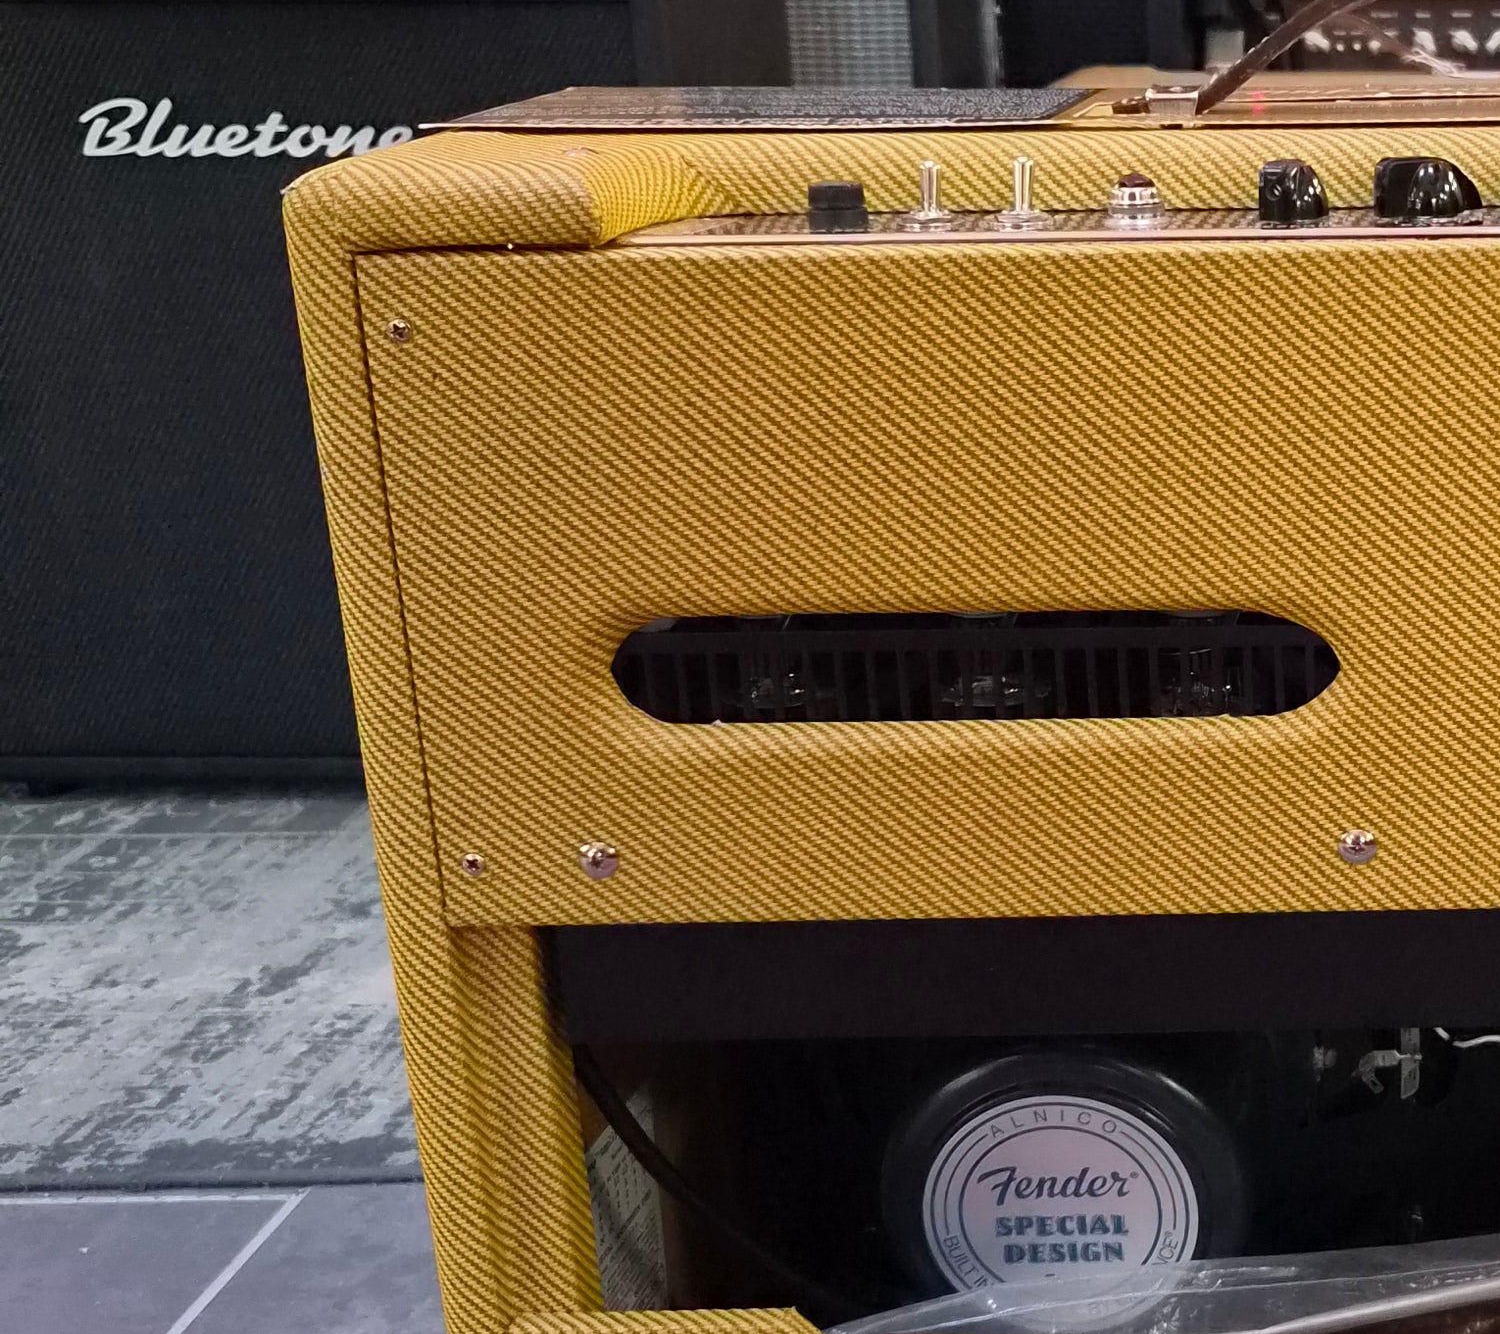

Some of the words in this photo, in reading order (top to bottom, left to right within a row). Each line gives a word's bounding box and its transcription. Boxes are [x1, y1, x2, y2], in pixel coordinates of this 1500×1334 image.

[78, 97, 413, 158] Bluetone
[990, 1108, 1117, 1139] ALNICO
[995, 1213, 1129, 1238] SPECIAL
[944, 1234, 979, 1280] BUILT
[1003, 1241, 1125, 1264] DESIGN
